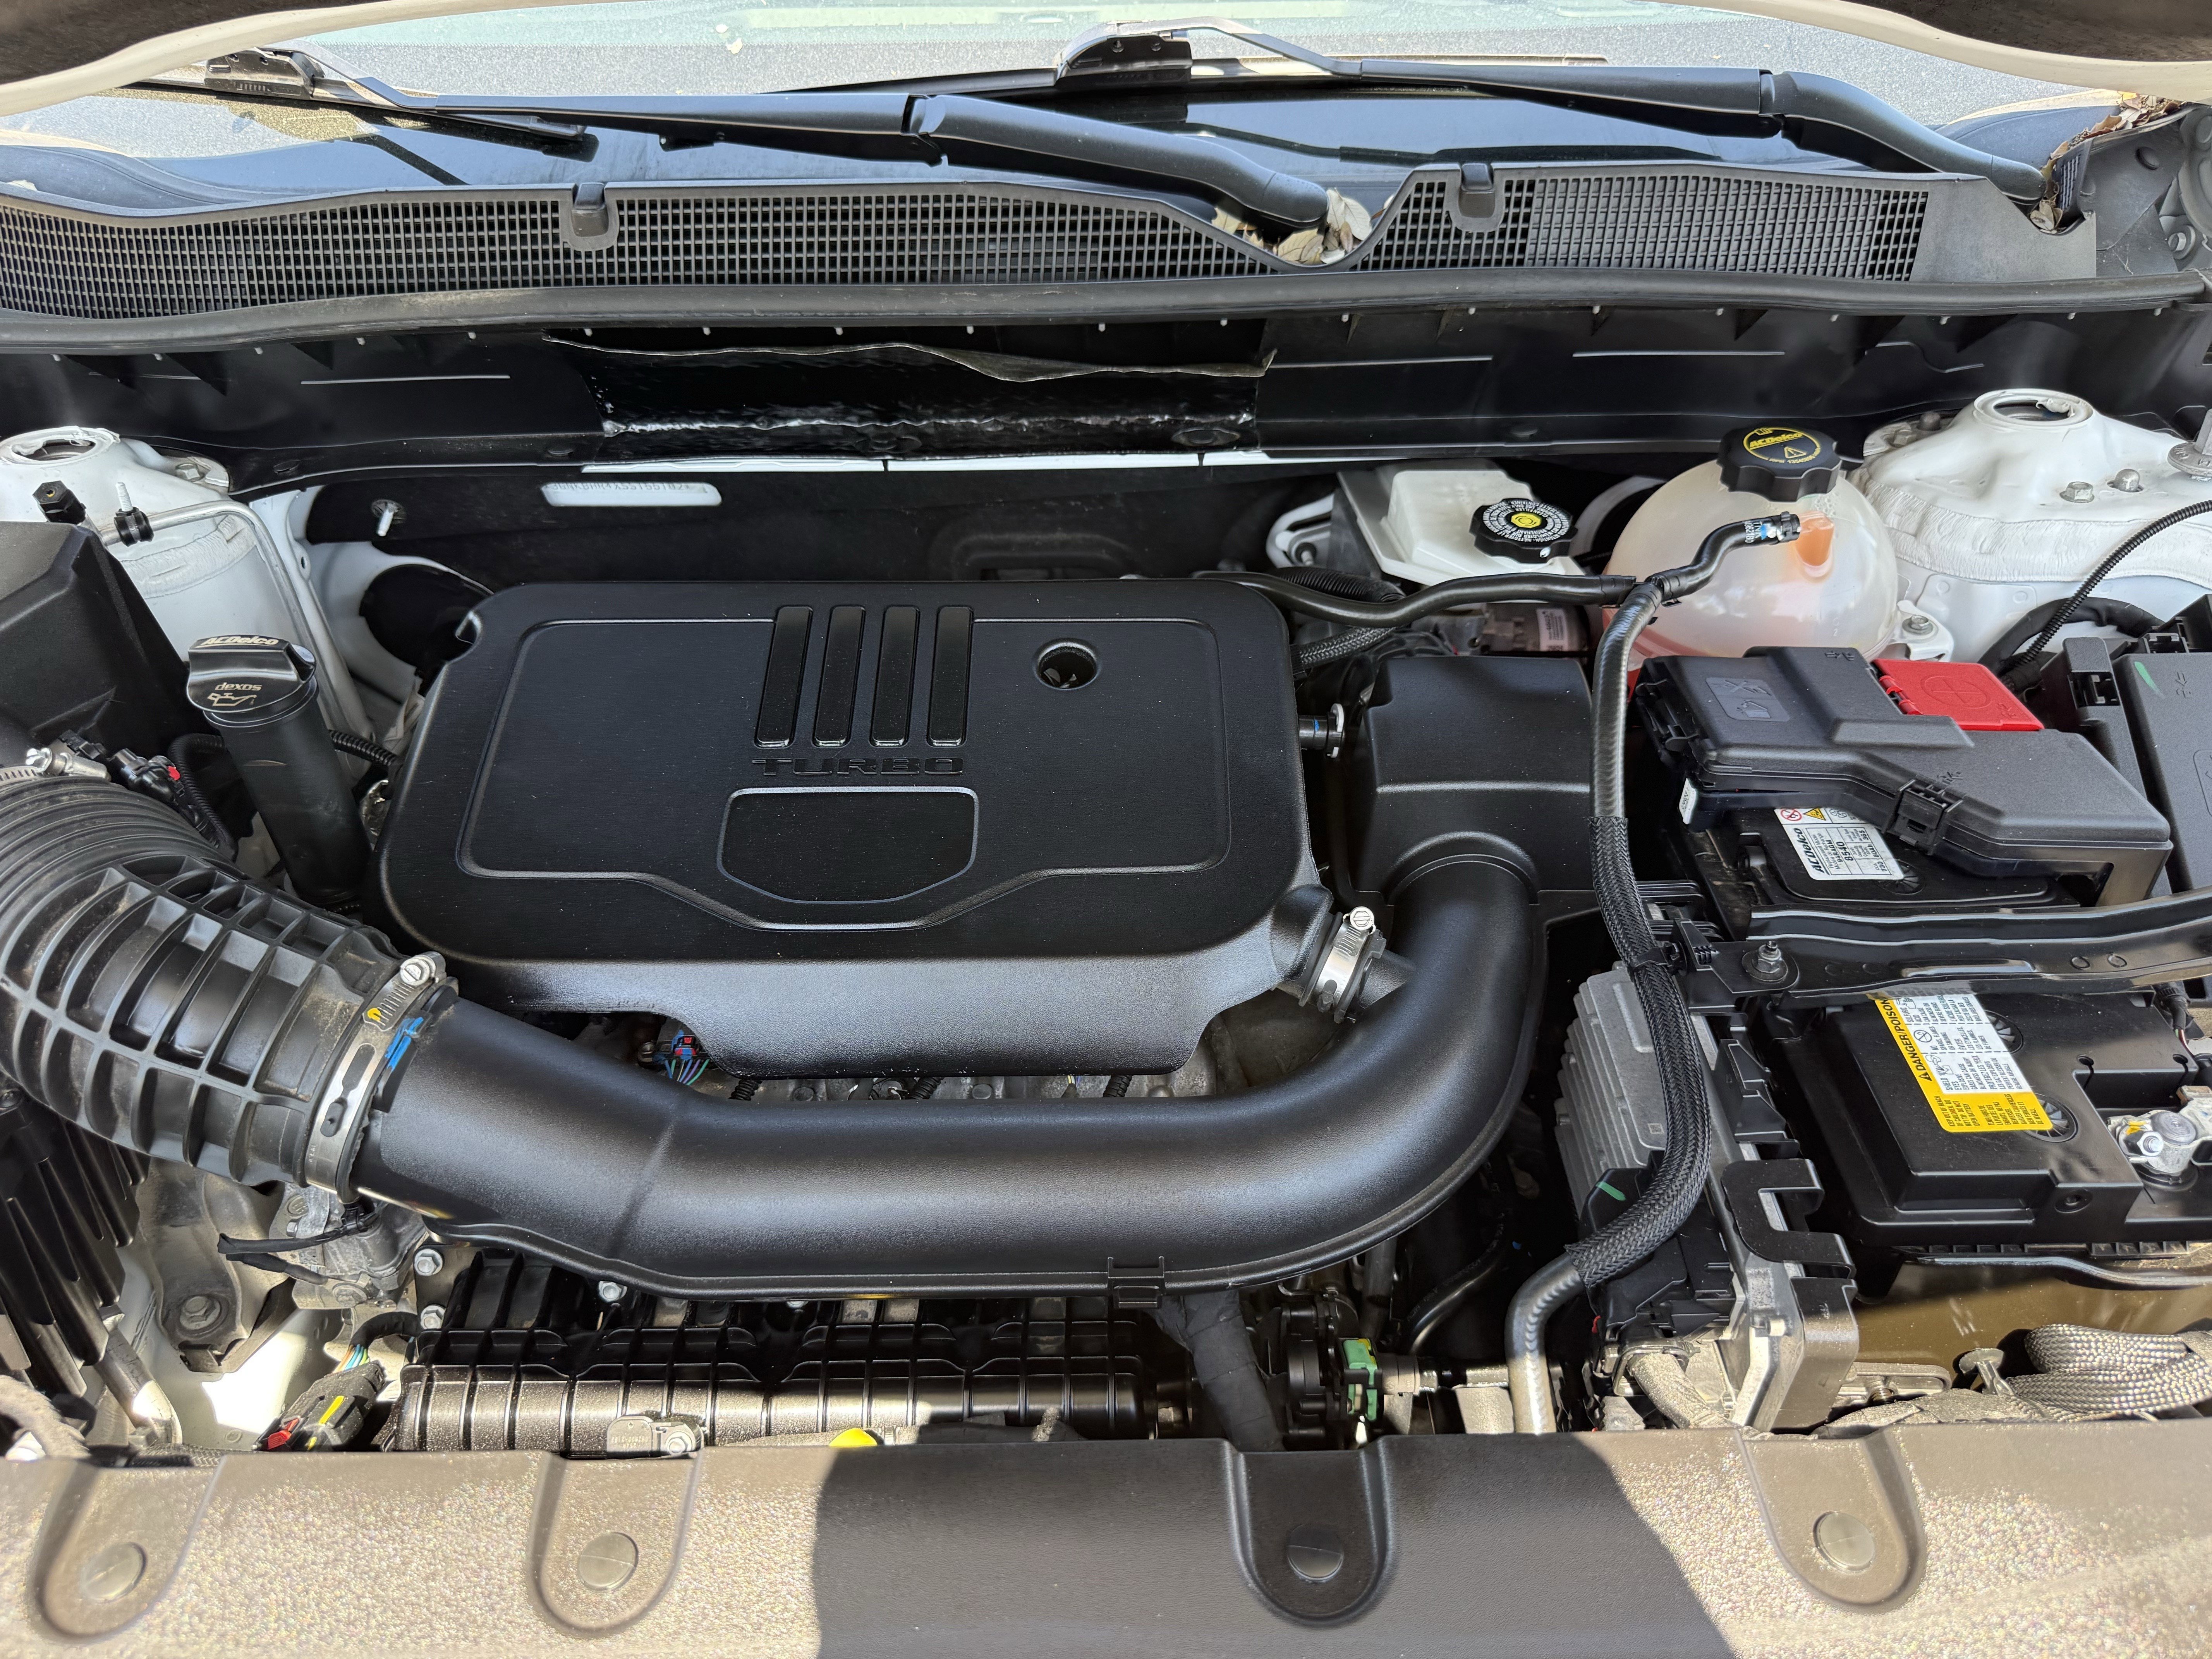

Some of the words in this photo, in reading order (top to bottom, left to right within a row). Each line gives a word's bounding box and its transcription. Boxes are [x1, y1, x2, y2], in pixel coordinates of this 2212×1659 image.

[1750, 433, 1803, 447] ACDelco
[201, 636, 279, 645] ACDelco
[215, 682, 262, 691] dexos
[752, 757, 964, 776] TURBO
[1858, 830, 1869, 840] 365
[1794, 828, 1824, 873] ACDelco
[1836, 842, 1853, 861] 8540
[1867, 844, 1879, 857] 80Ah
[1877, 861, 1887, 872] 730
[1880, 999, 1925, 1071] DANGER/POISON
[1929, 1026, 1939, 1037] FLAMES
[1971, 1055, 1982, 1064] YEUX
[1958, 1063, 1968, 1073] CAUSE
[1984, 1061, 1998, 1077] EXPLOSIFS
[1993, 1062, 2006, 1075] BLESSER
[2002, 1063, 2014, 1077] AVEUGLE
[1940, 1077, 1953, 1090] SHIELD
[1951, 1081, 1962, 1090] EYES
[1955, 1074, 1970, 1090] EXPLOSIVE
[1967, 1080, 1978, 1090] GASES
[1972, 1073, 1986, 1089] BLINDNESS
[2001, 1076, 2014, 1089] PEUVENT
[2011, 1077, 2022, 1089] RENDRE
[1934, 1096, 1944, 1106] REACH
[2004, 1094, 2020, 1112] COUVERCLES
[1962, 1103, 1975, 1117] BATTERY
[1946, 1118, 1955, 1127] KEEP
[1970, 1117, 1980, 1126] OPEN
[1985, 1117, 1994, 1125] TENIR
[2015, 1113, 2027, 1124] GARDER
